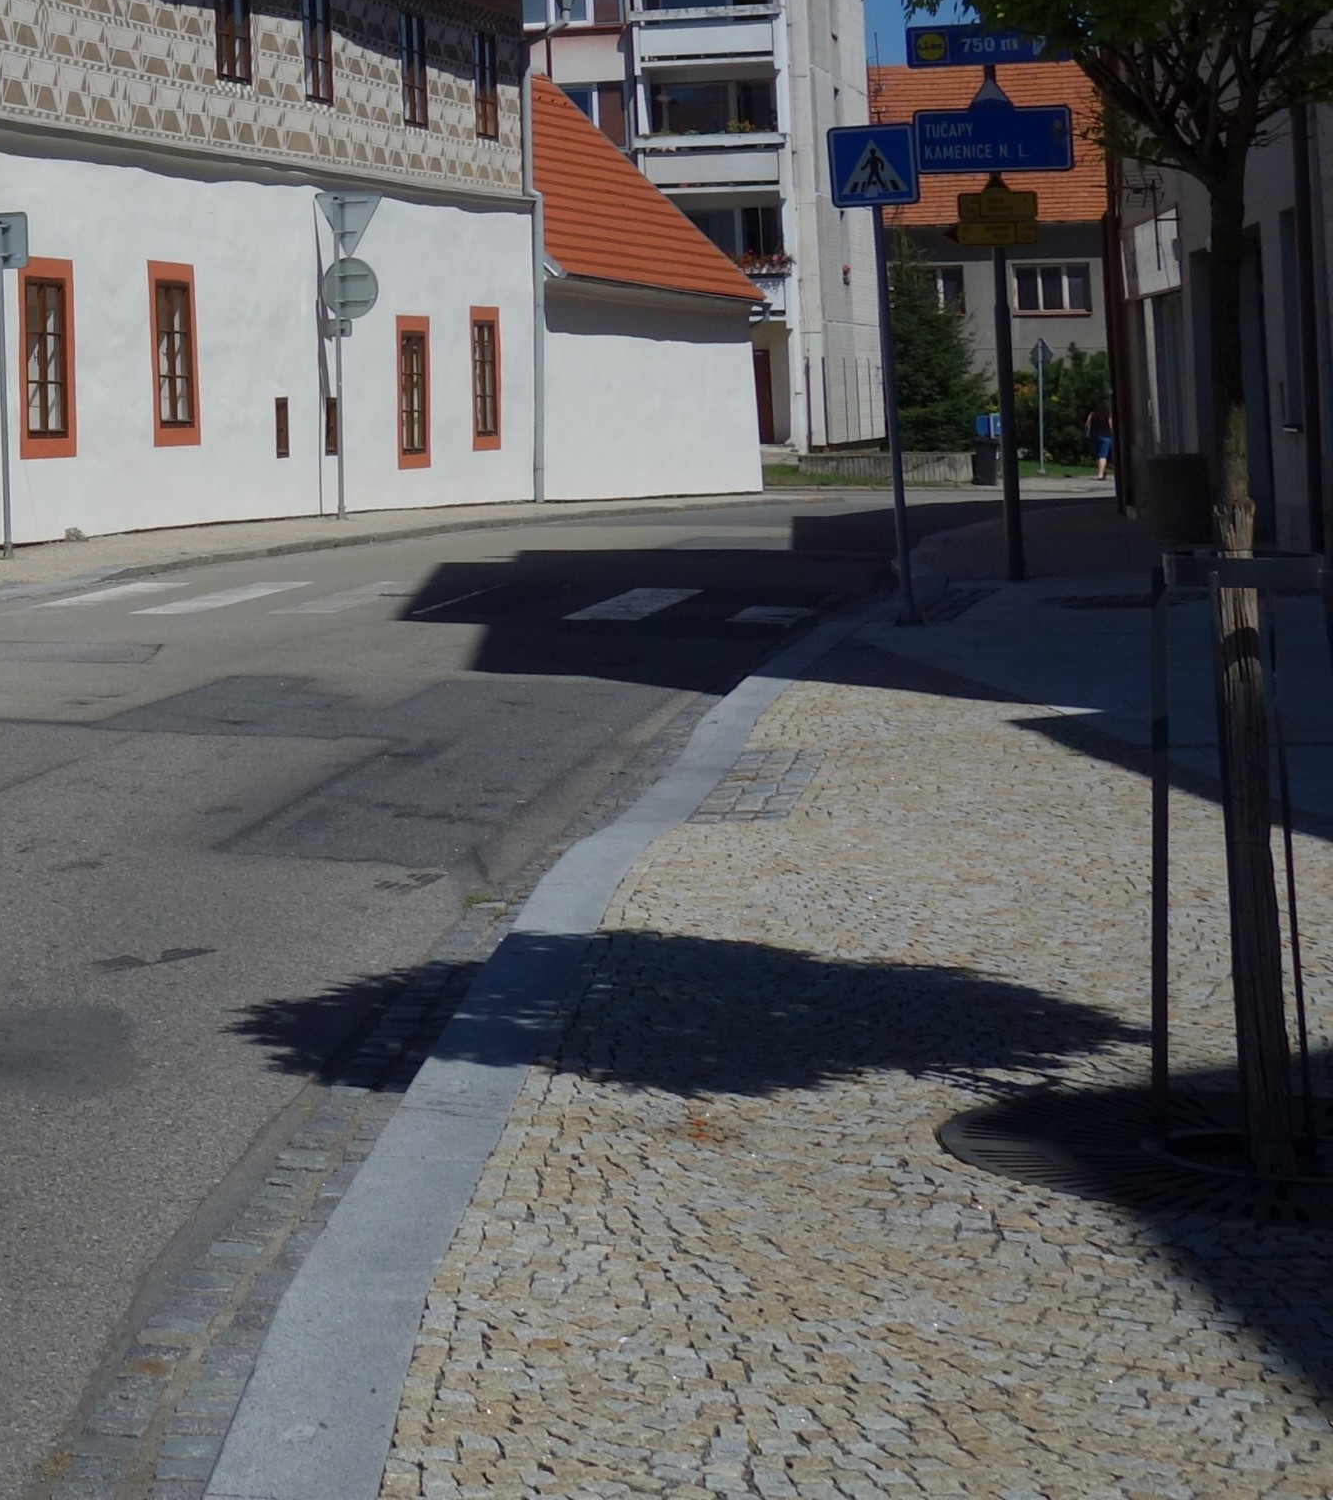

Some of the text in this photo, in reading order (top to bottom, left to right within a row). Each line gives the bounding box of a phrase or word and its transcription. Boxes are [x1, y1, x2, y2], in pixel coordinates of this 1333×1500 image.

[961, 37, 996, 53] 750
[924, 121, 974, 139] TUČAPY
[924, 143, 1030, 160] KAMENICE N. L.
